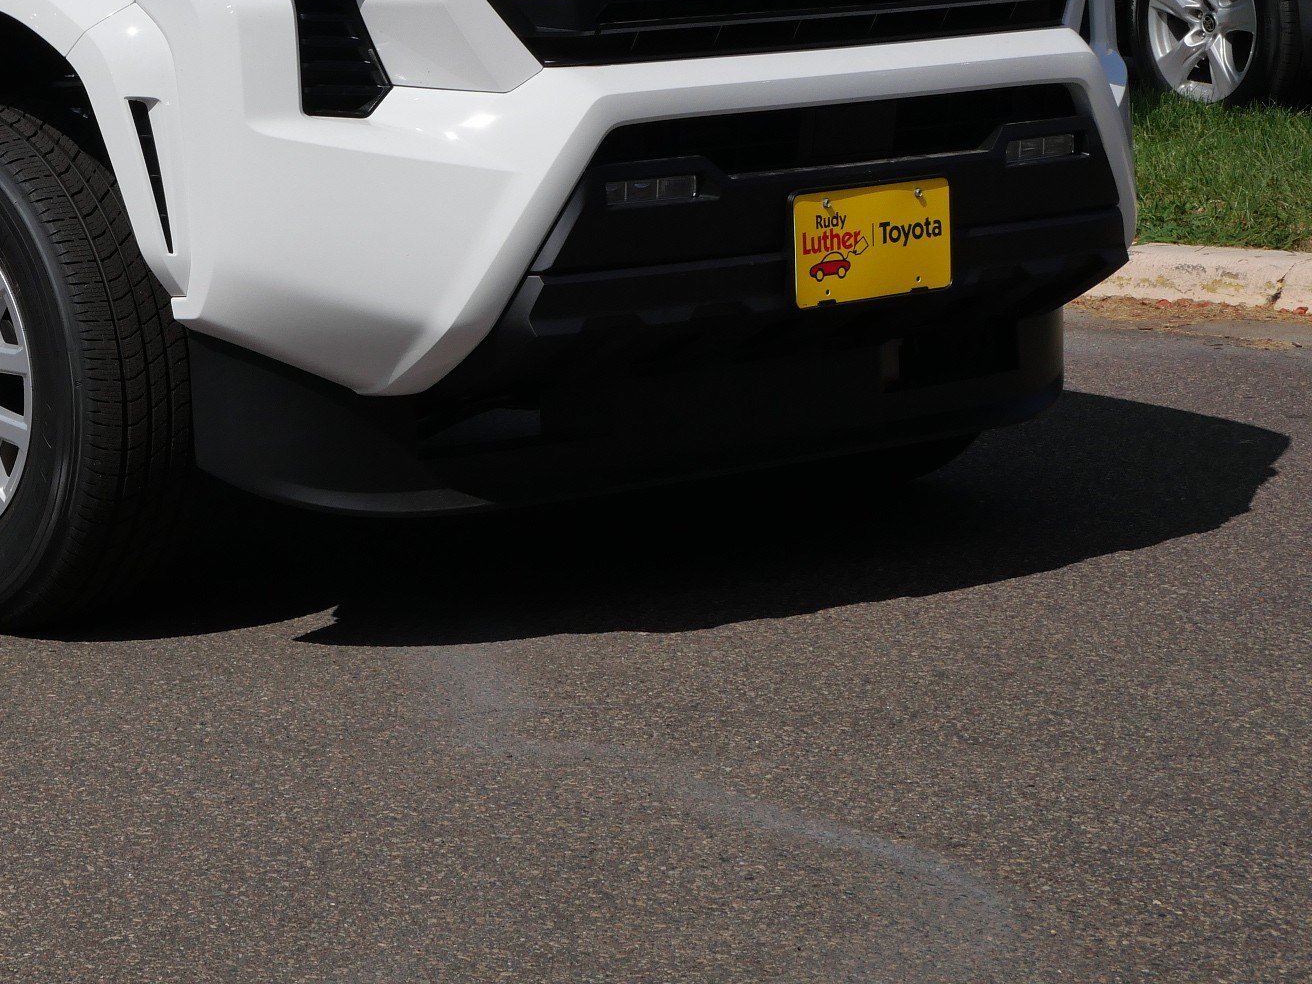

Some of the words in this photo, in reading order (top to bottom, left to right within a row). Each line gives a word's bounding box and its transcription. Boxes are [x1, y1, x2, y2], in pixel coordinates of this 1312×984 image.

[816, 212, 846, 229] Rudy
[802, 228, 861, 255] Luther
[879, 217, 943, 247] Toyota
